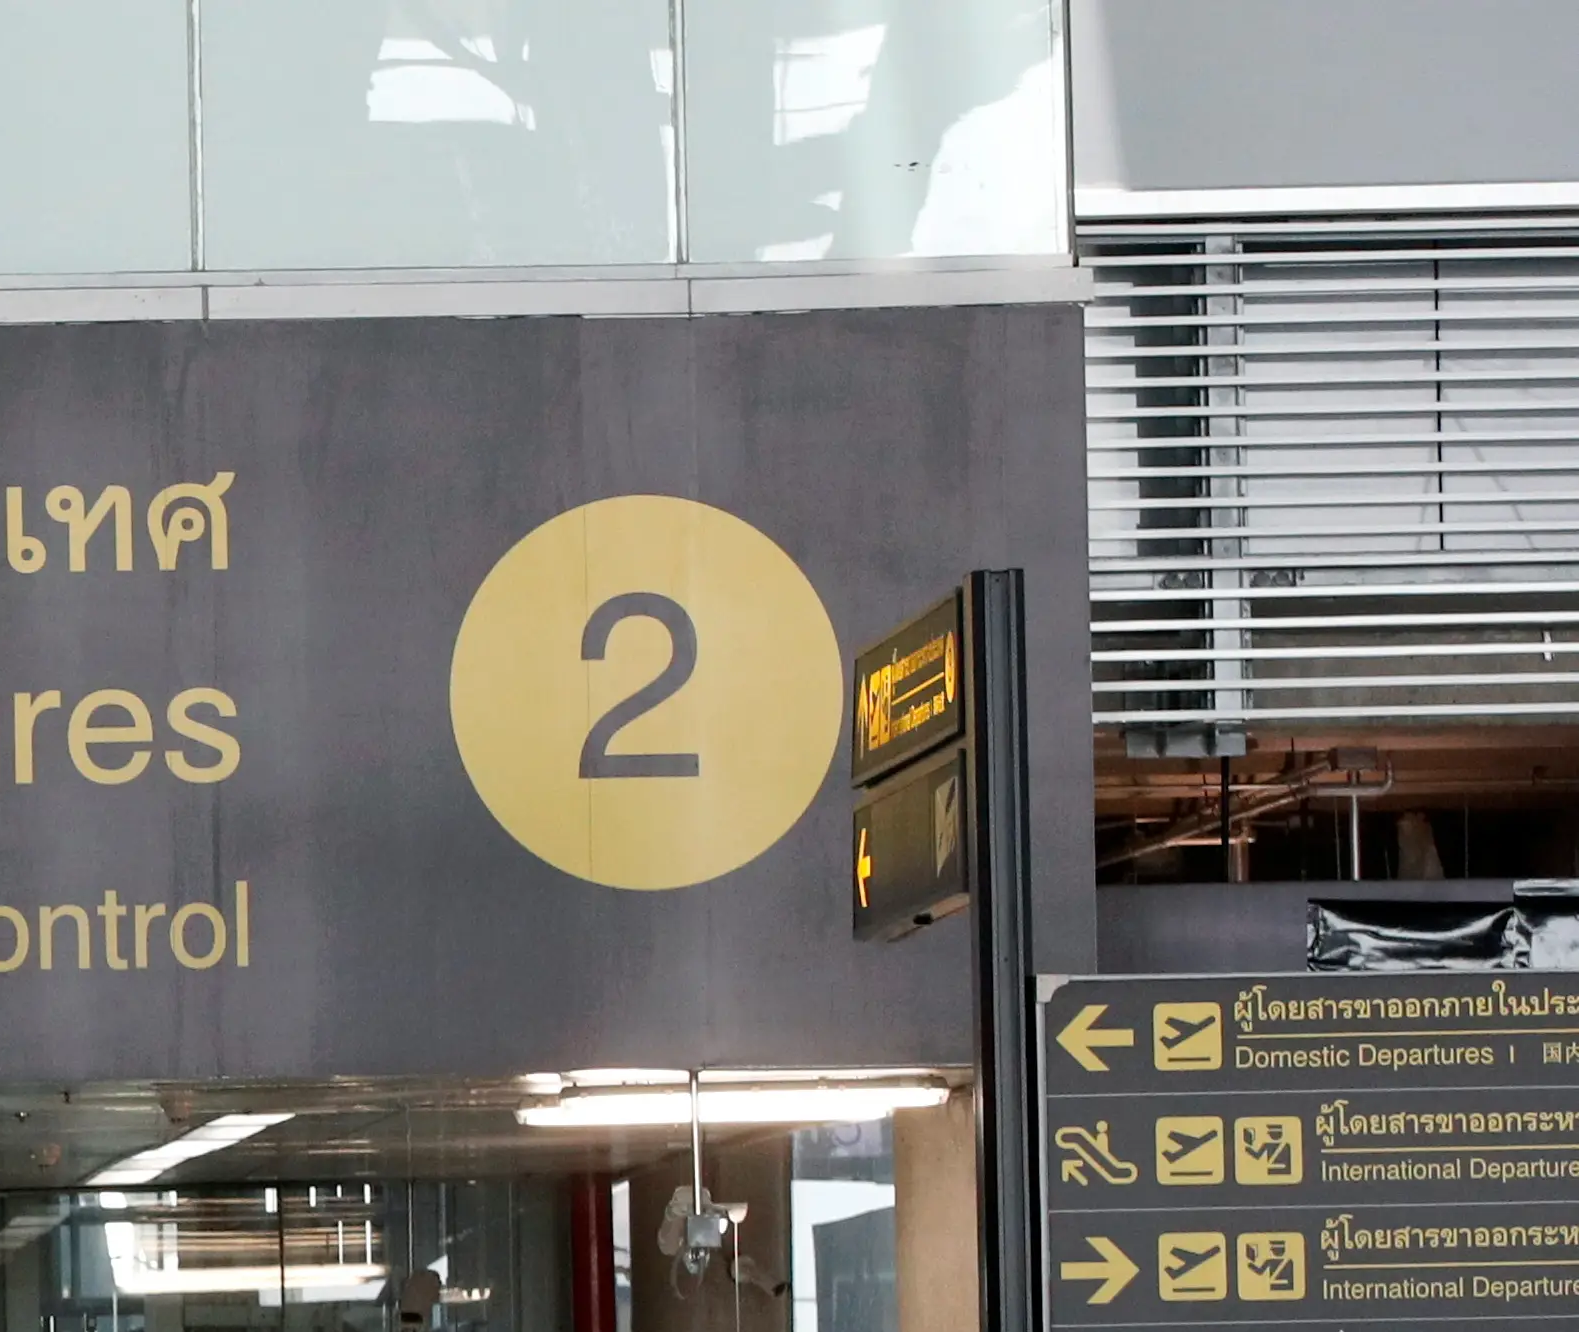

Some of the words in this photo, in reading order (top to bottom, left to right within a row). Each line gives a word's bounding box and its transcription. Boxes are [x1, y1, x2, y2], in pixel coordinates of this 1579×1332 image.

[579, 591, 700, 779] 2
[1235, 1045, 1351, 1069] Domestic
[1358, 1043, 1495, 1071] Departures
[1321, 1157, 1461, 1182] International
[1323, 1277, 1464, 1300] International
